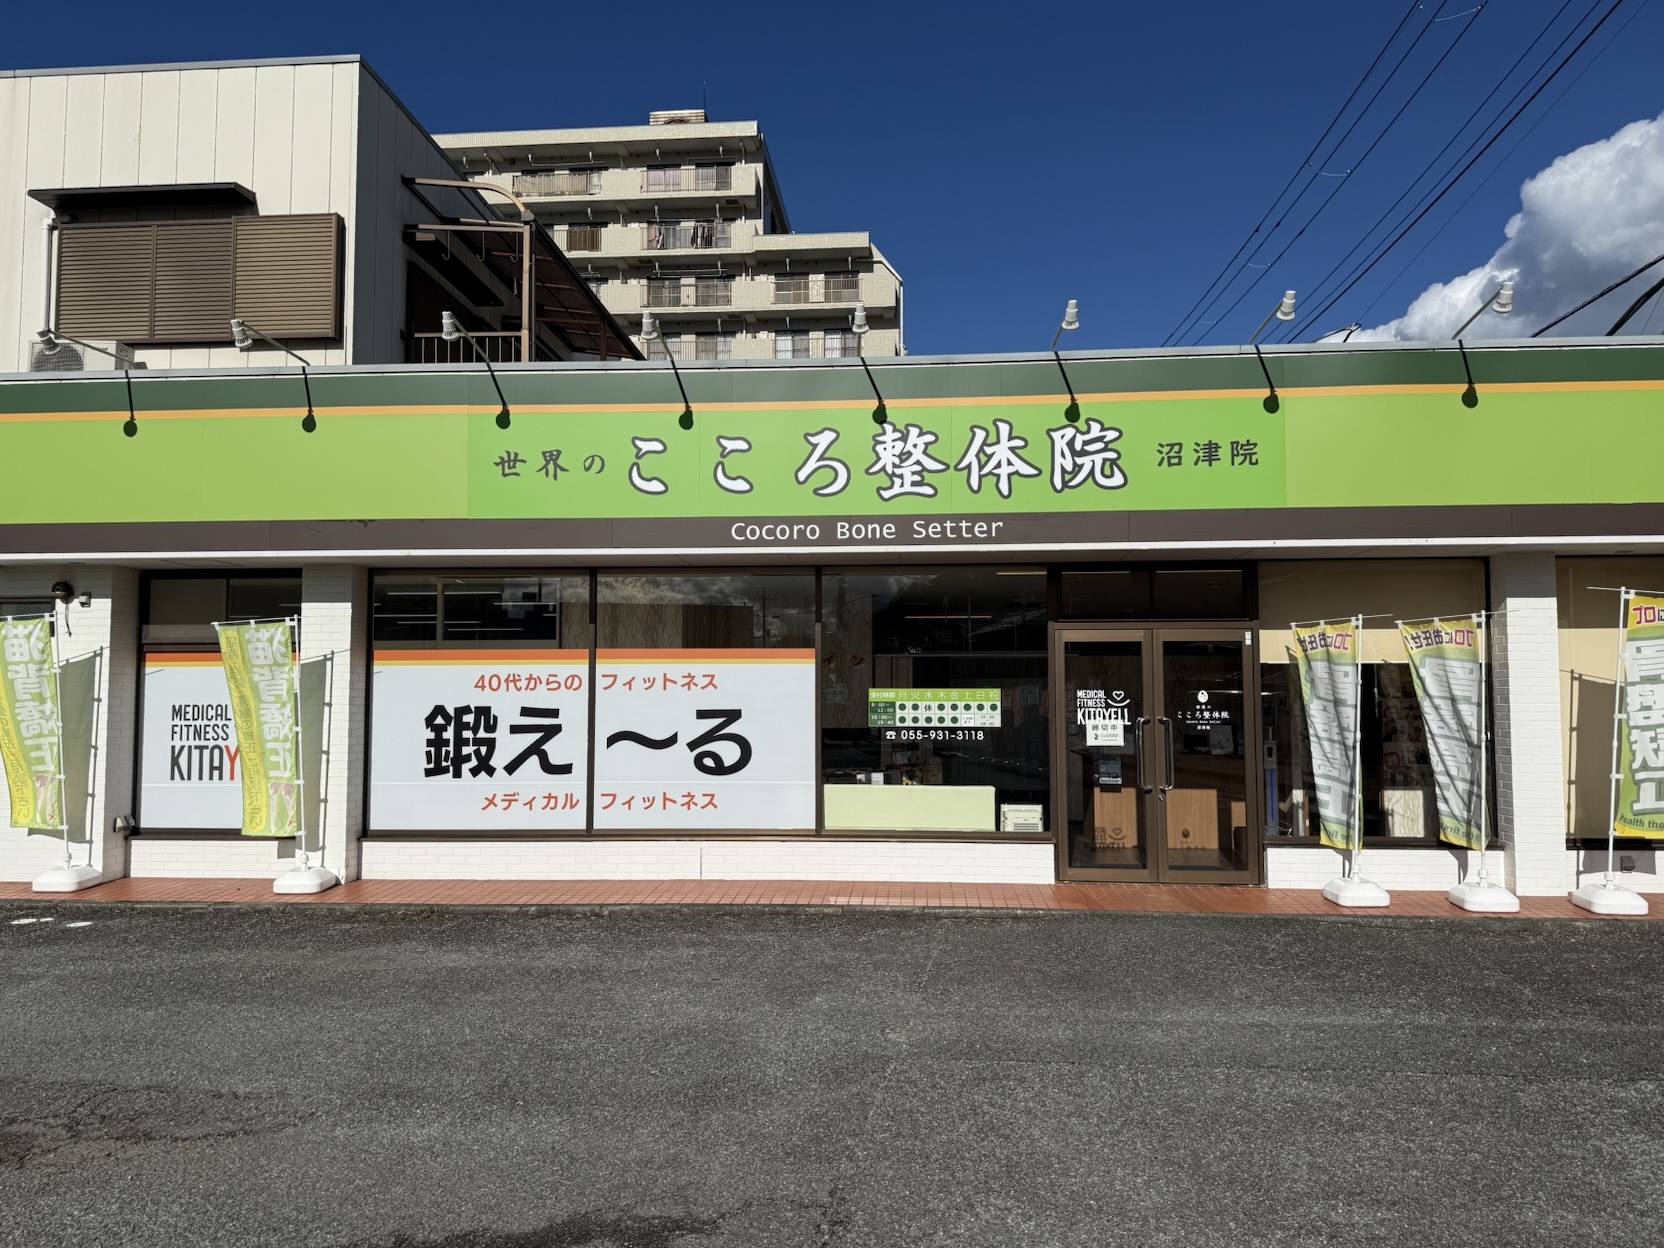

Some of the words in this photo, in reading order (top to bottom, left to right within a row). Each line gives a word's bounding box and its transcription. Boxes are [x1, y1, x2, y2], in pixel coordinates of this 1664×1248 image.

[493, 449, 606, 481] 世界の
[628, 417, 1128, 500] こころ整体院
[1156, 440, 1260, 468] 沼津院
[730, 521, 821, 541] Cocoro
[836, 521, 897, 540] Bone
[912, 520, 1004, 538] Setter
[474, 673, 583, 692] 40代からの
[600, 672, 719, 691] フィットネス
[911, 690, 920, 700] 火
[924, 690, 933, 700] 水
[937, 690, 947, 700] 木
[950, 690, 960, 700] 金
[963, 690, 972, 700] 土
[976, 690, 985, 700] 日
[1076, 689, 1106, 698] MEDICAL
[923, 704, 933, 713] 休
[1076, 698, 1105, 707] FITNESS
[171, 704, 232, 721] MEDICAL
[171, 724, 229, 741] FITNESS
[900, 730, 984, 740] 055-931-3118
[170, 745, 239, 781] KITAY
[481, 792, 580, 811] メディカル
[600, 791, 719, 811] フィットネス
